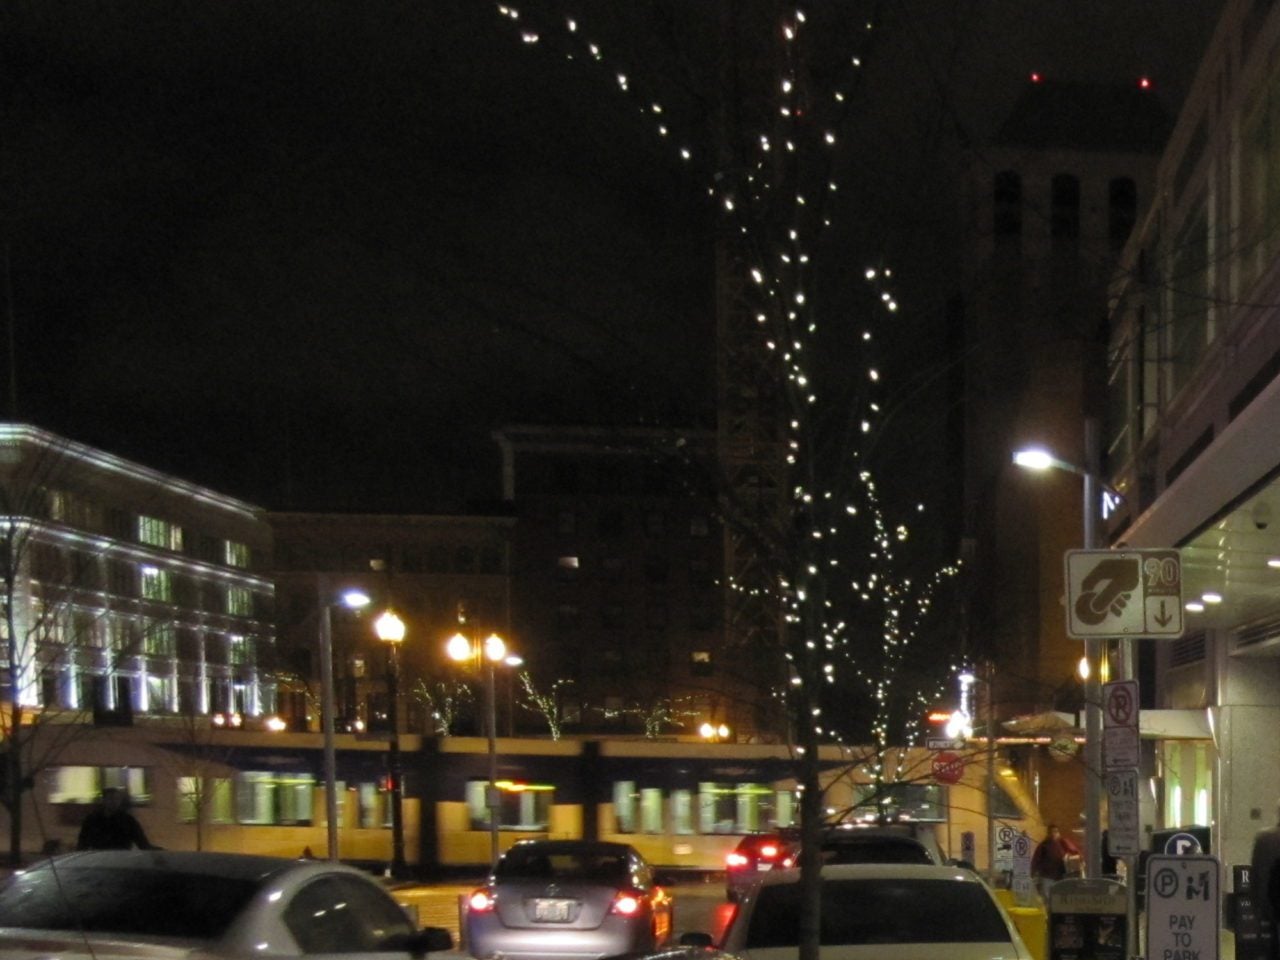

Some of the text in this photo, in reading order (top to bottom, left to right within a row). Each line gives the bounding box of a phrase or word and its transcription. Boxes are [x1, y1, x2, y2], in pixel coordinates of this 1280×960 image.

[1144, 557, 1179, 586] 90
[1169, 914, 1195, 930] PAY
[1172, 932, 1192, 947] TO
